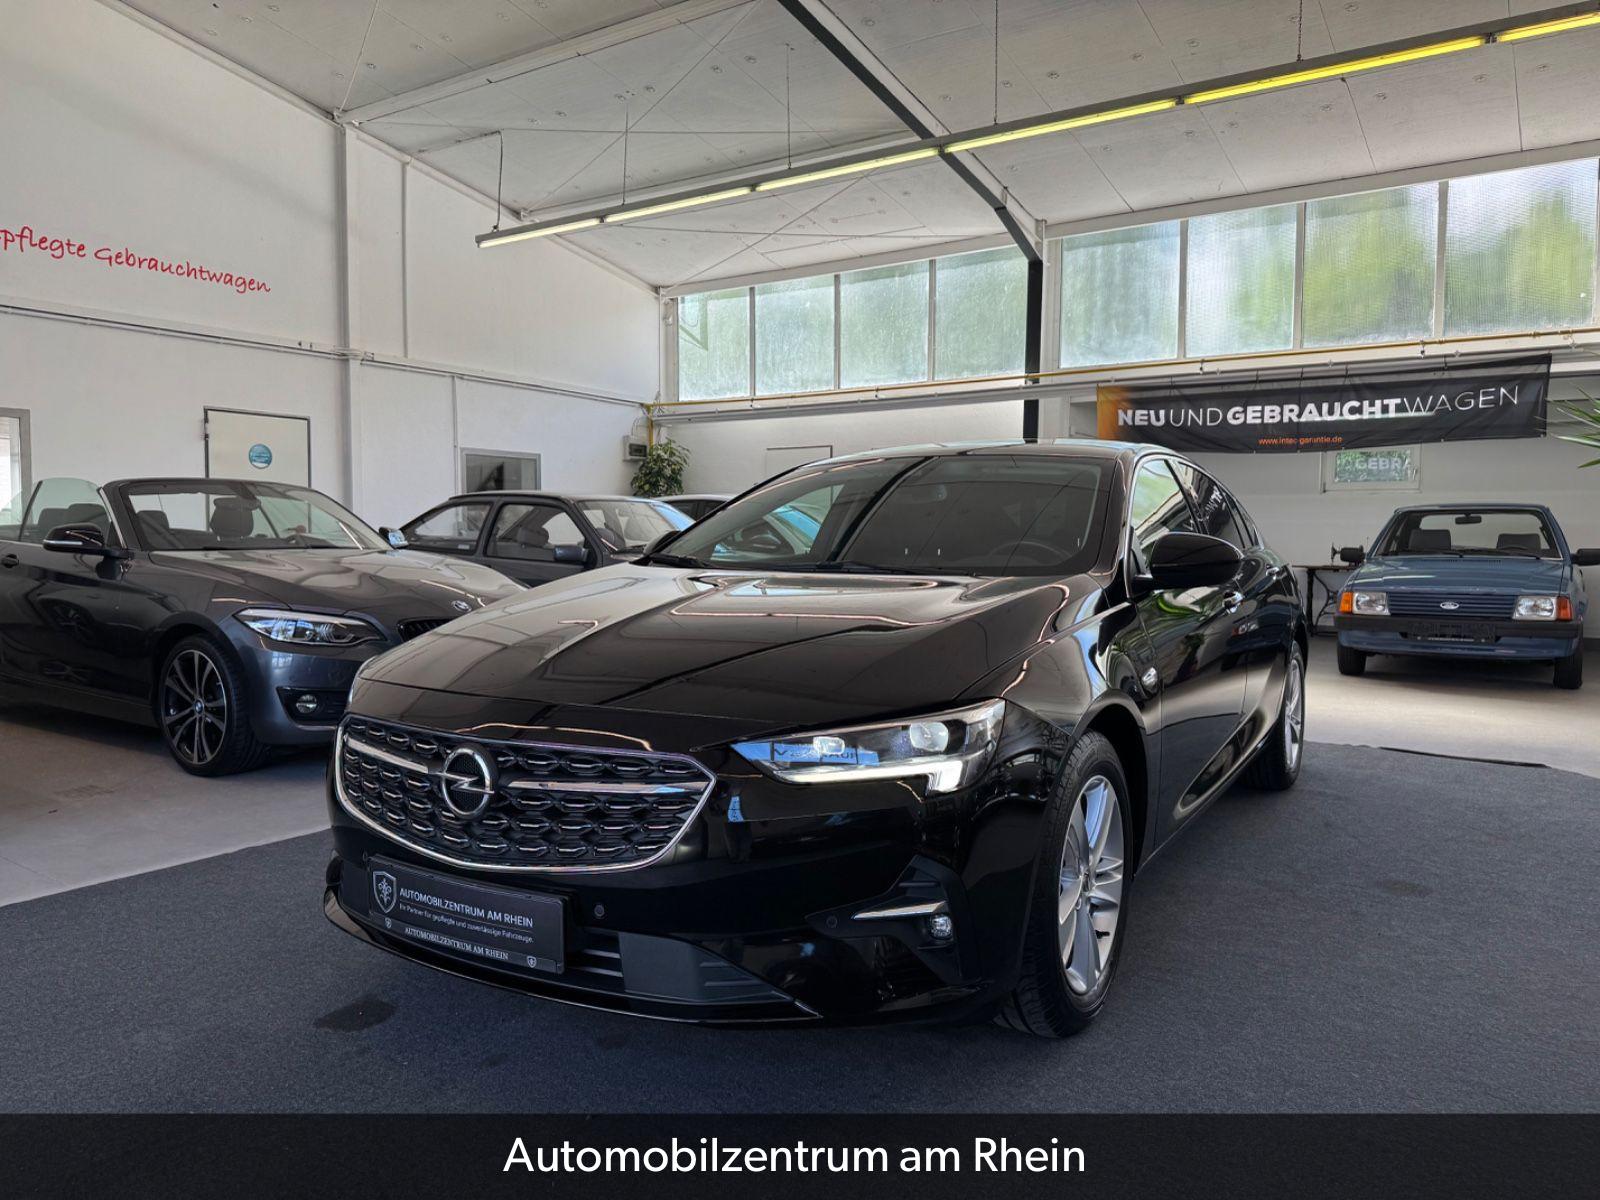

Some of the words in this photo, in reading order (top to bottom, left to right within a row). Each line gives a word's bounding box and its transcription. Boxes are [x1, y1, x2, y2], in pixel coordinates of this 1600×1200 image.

[0, 226, 87, 260] pflegte
[93, 248, 271, 294] Gebrauchtwagen
[1117, 408, 1166, 427] NEU
[1169, 407, 1223, 427] UND
[399, 887, 485, 918] AUTOMOBILZENTRUM
[486, 910, 502, 922] AM
[503, 913, 533, 928] RHEIN
[404, 927, 472, 952] AUTOMOBILZENTRUM
[473, 945, 484, 955] AM
[485, 948, 509, 960] RHEIN
